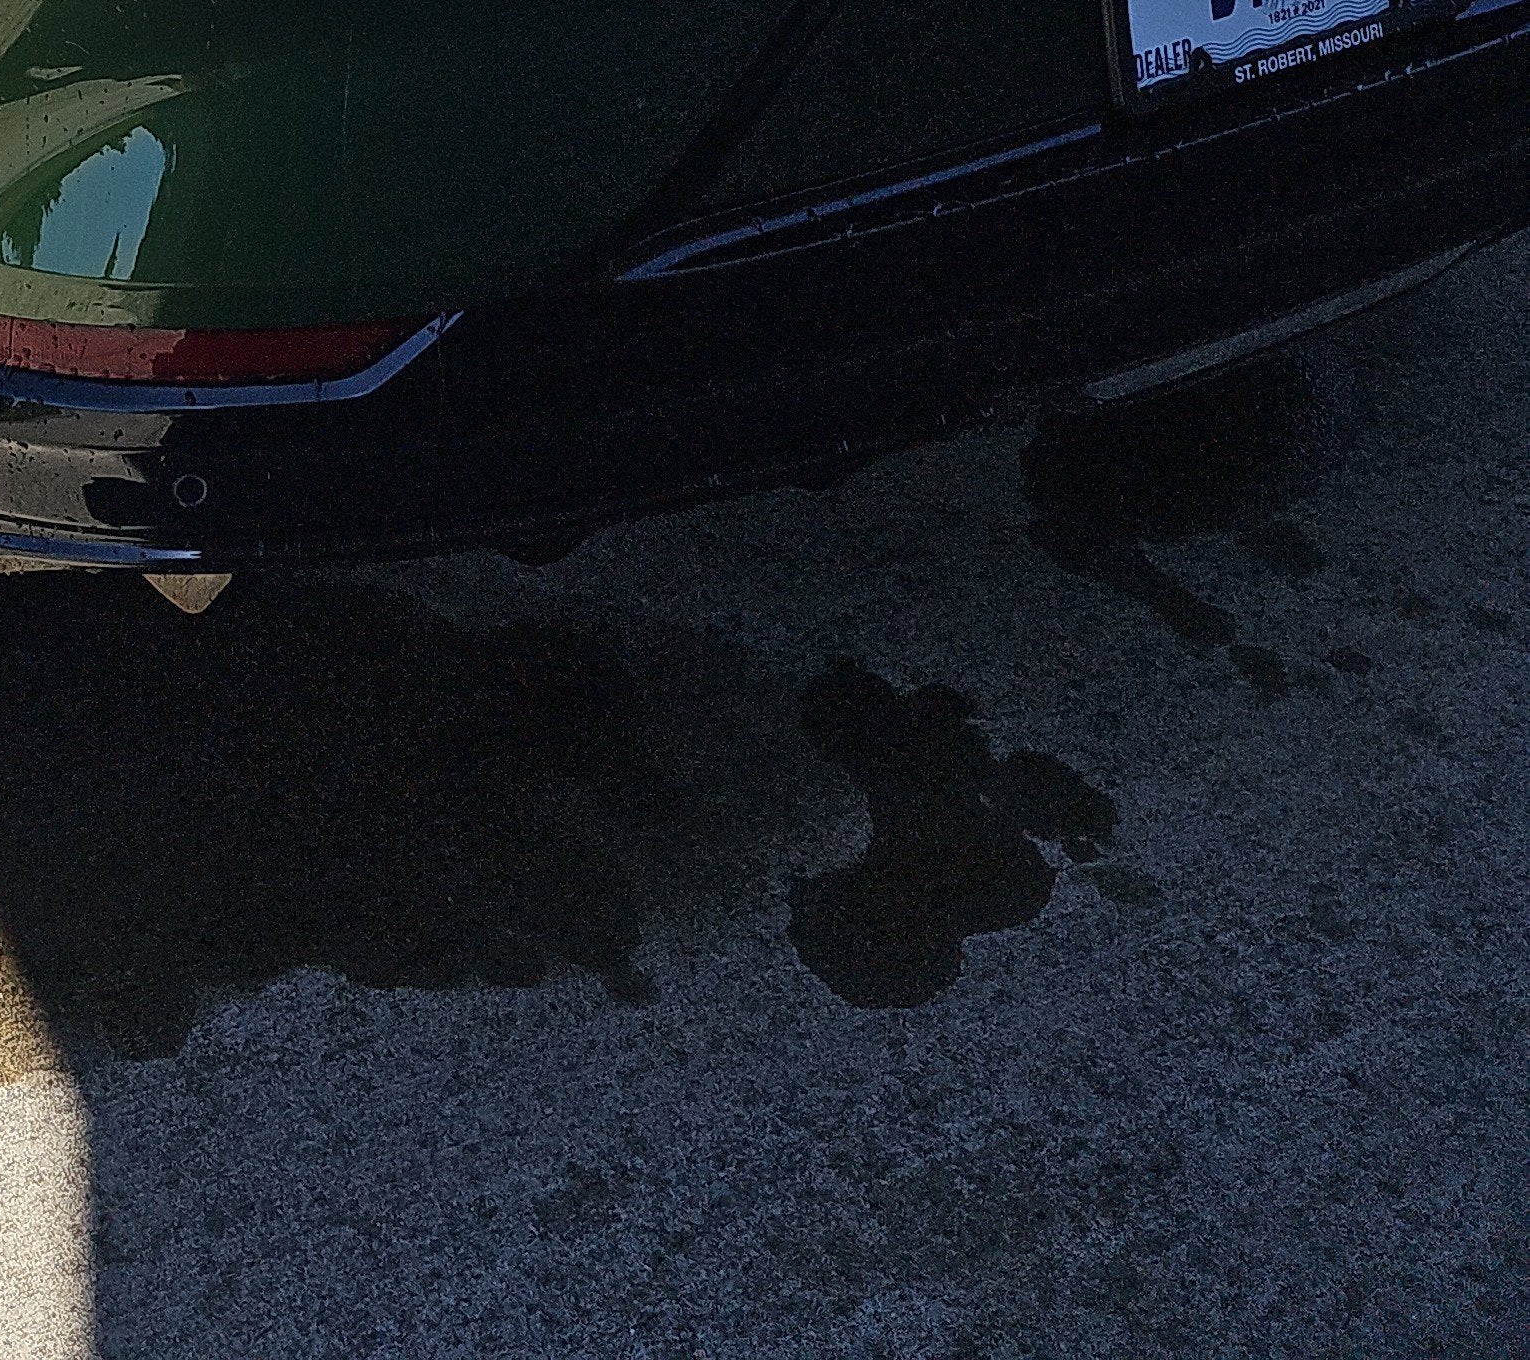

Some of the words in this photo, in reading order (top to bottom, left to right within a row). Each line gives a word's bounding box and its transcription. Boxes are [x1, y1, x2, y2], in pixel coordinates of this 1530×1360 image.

[1268, 6, 1293, 26] 1821
[1135, 38, 1192, 82] DEALER
[1234, 65, 1255, 84] ST.
[1257, 46, 1317, 78] ROBERT,
[1318, 22, 1384, 56] MISSOURI
